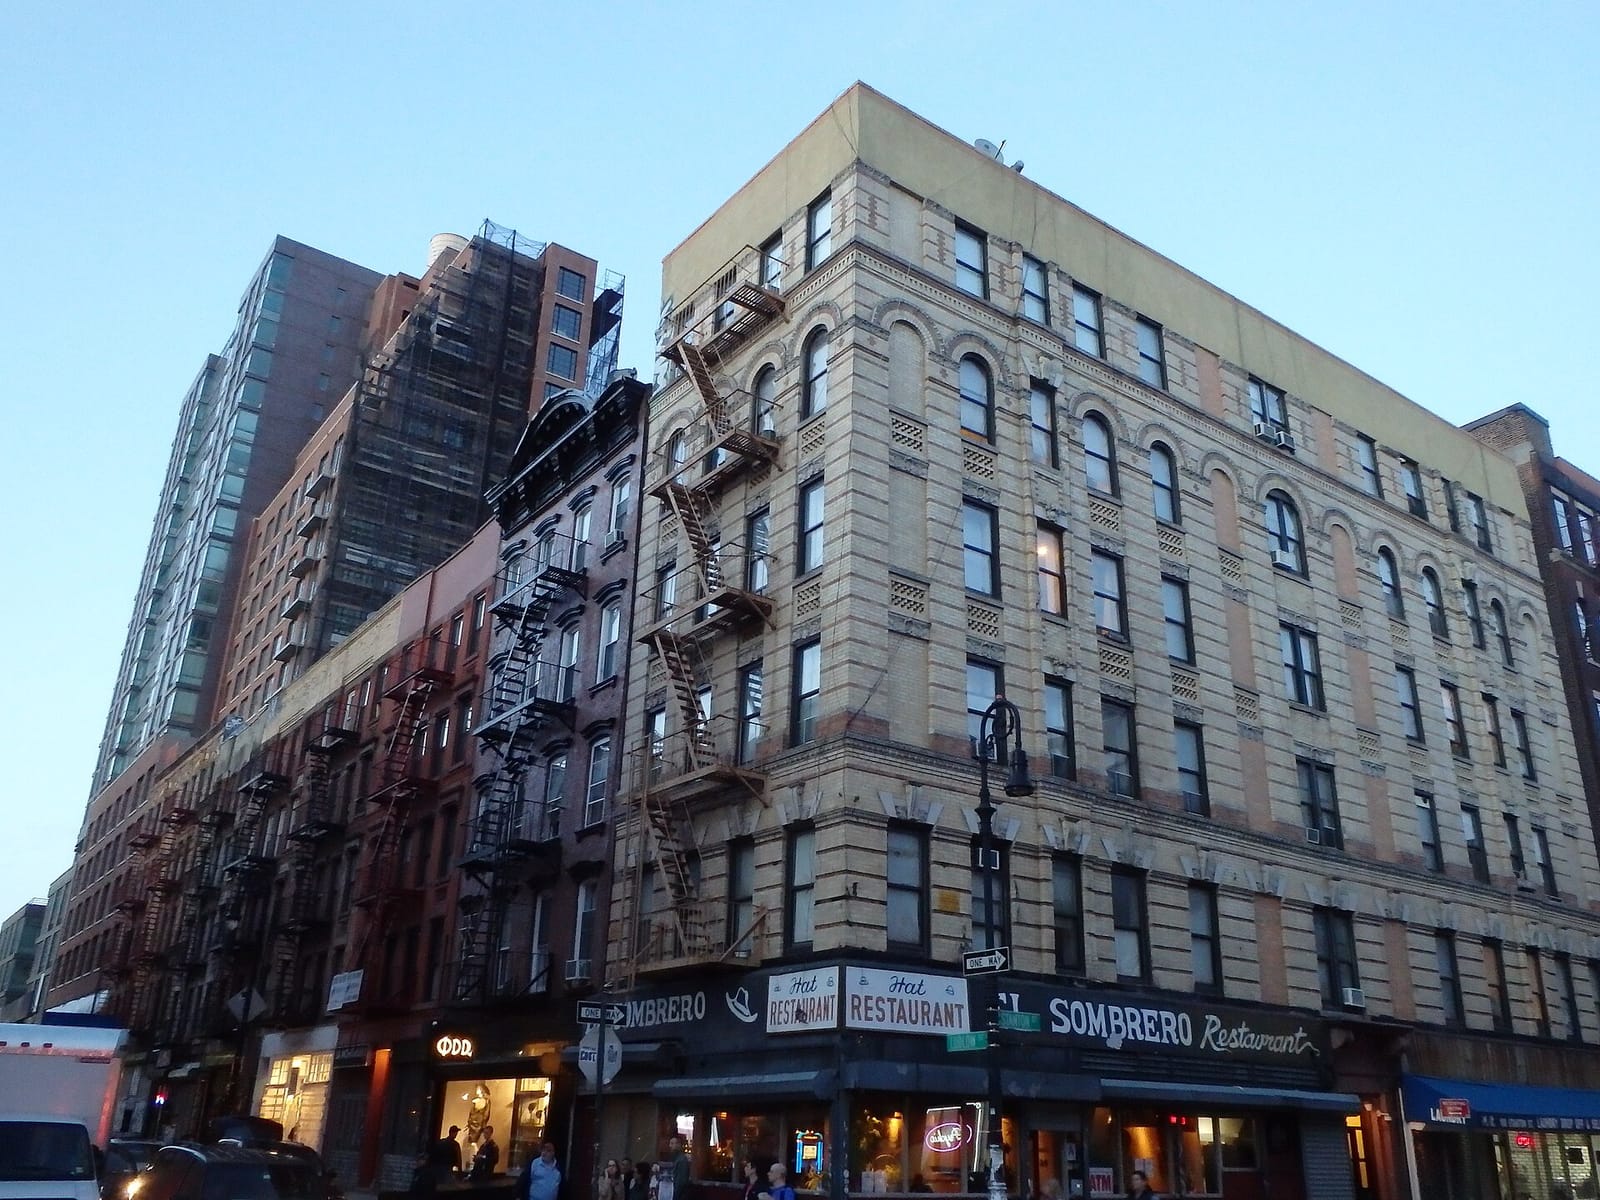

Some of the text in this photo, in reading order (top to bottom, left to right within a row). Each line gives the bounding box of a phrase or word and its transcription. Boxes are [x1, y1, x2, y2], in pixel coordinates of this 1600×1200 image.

[970, 955, 1002, 968] ONE WAY
[789, 976, 818, 995] Hat
[889, 975, 927, 996] Hat
[584, 1008, 600, 1018] ONE
[620, 991, 706, 1030] MBRERO
[769, 994, 836, 1026] RESTAURANT
[851, 993, 965, 1029] RESTAURANT
[1049, 998, 1193, 1047] SOMBRERO
[1200, 1014, 1321, 1057] Restaurant
[1090, 1174, 1112, 1192] ATM
